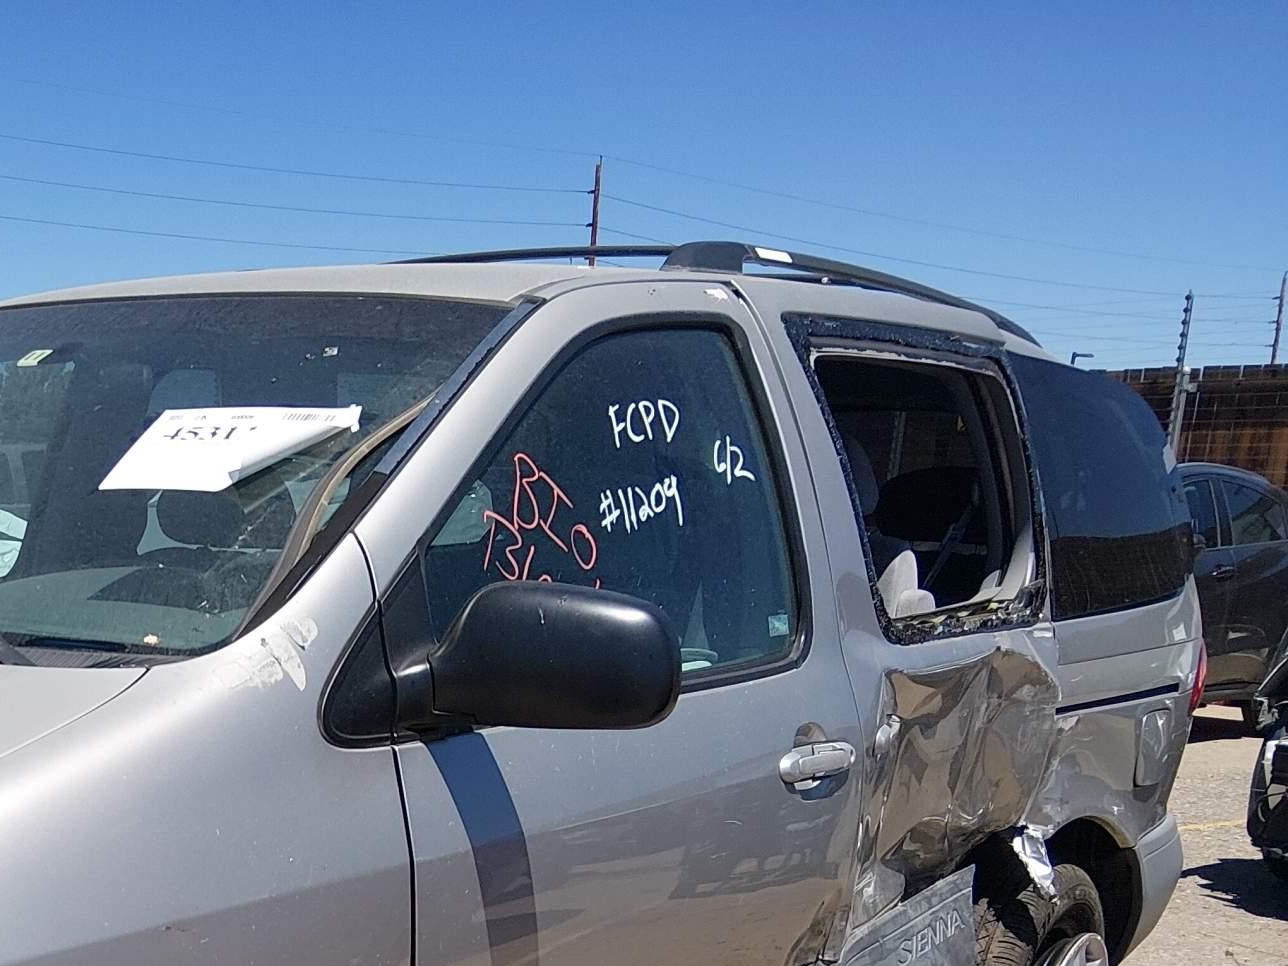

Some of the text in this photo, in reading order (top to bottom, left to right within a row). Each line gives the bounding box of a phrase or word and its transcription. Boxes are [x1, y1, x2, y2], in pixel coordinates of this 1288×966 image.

[608, 399, 680, 449] FCPD
[599, 474, 684, 534] #11209
[896, 908, 965, 966] SIENNA
